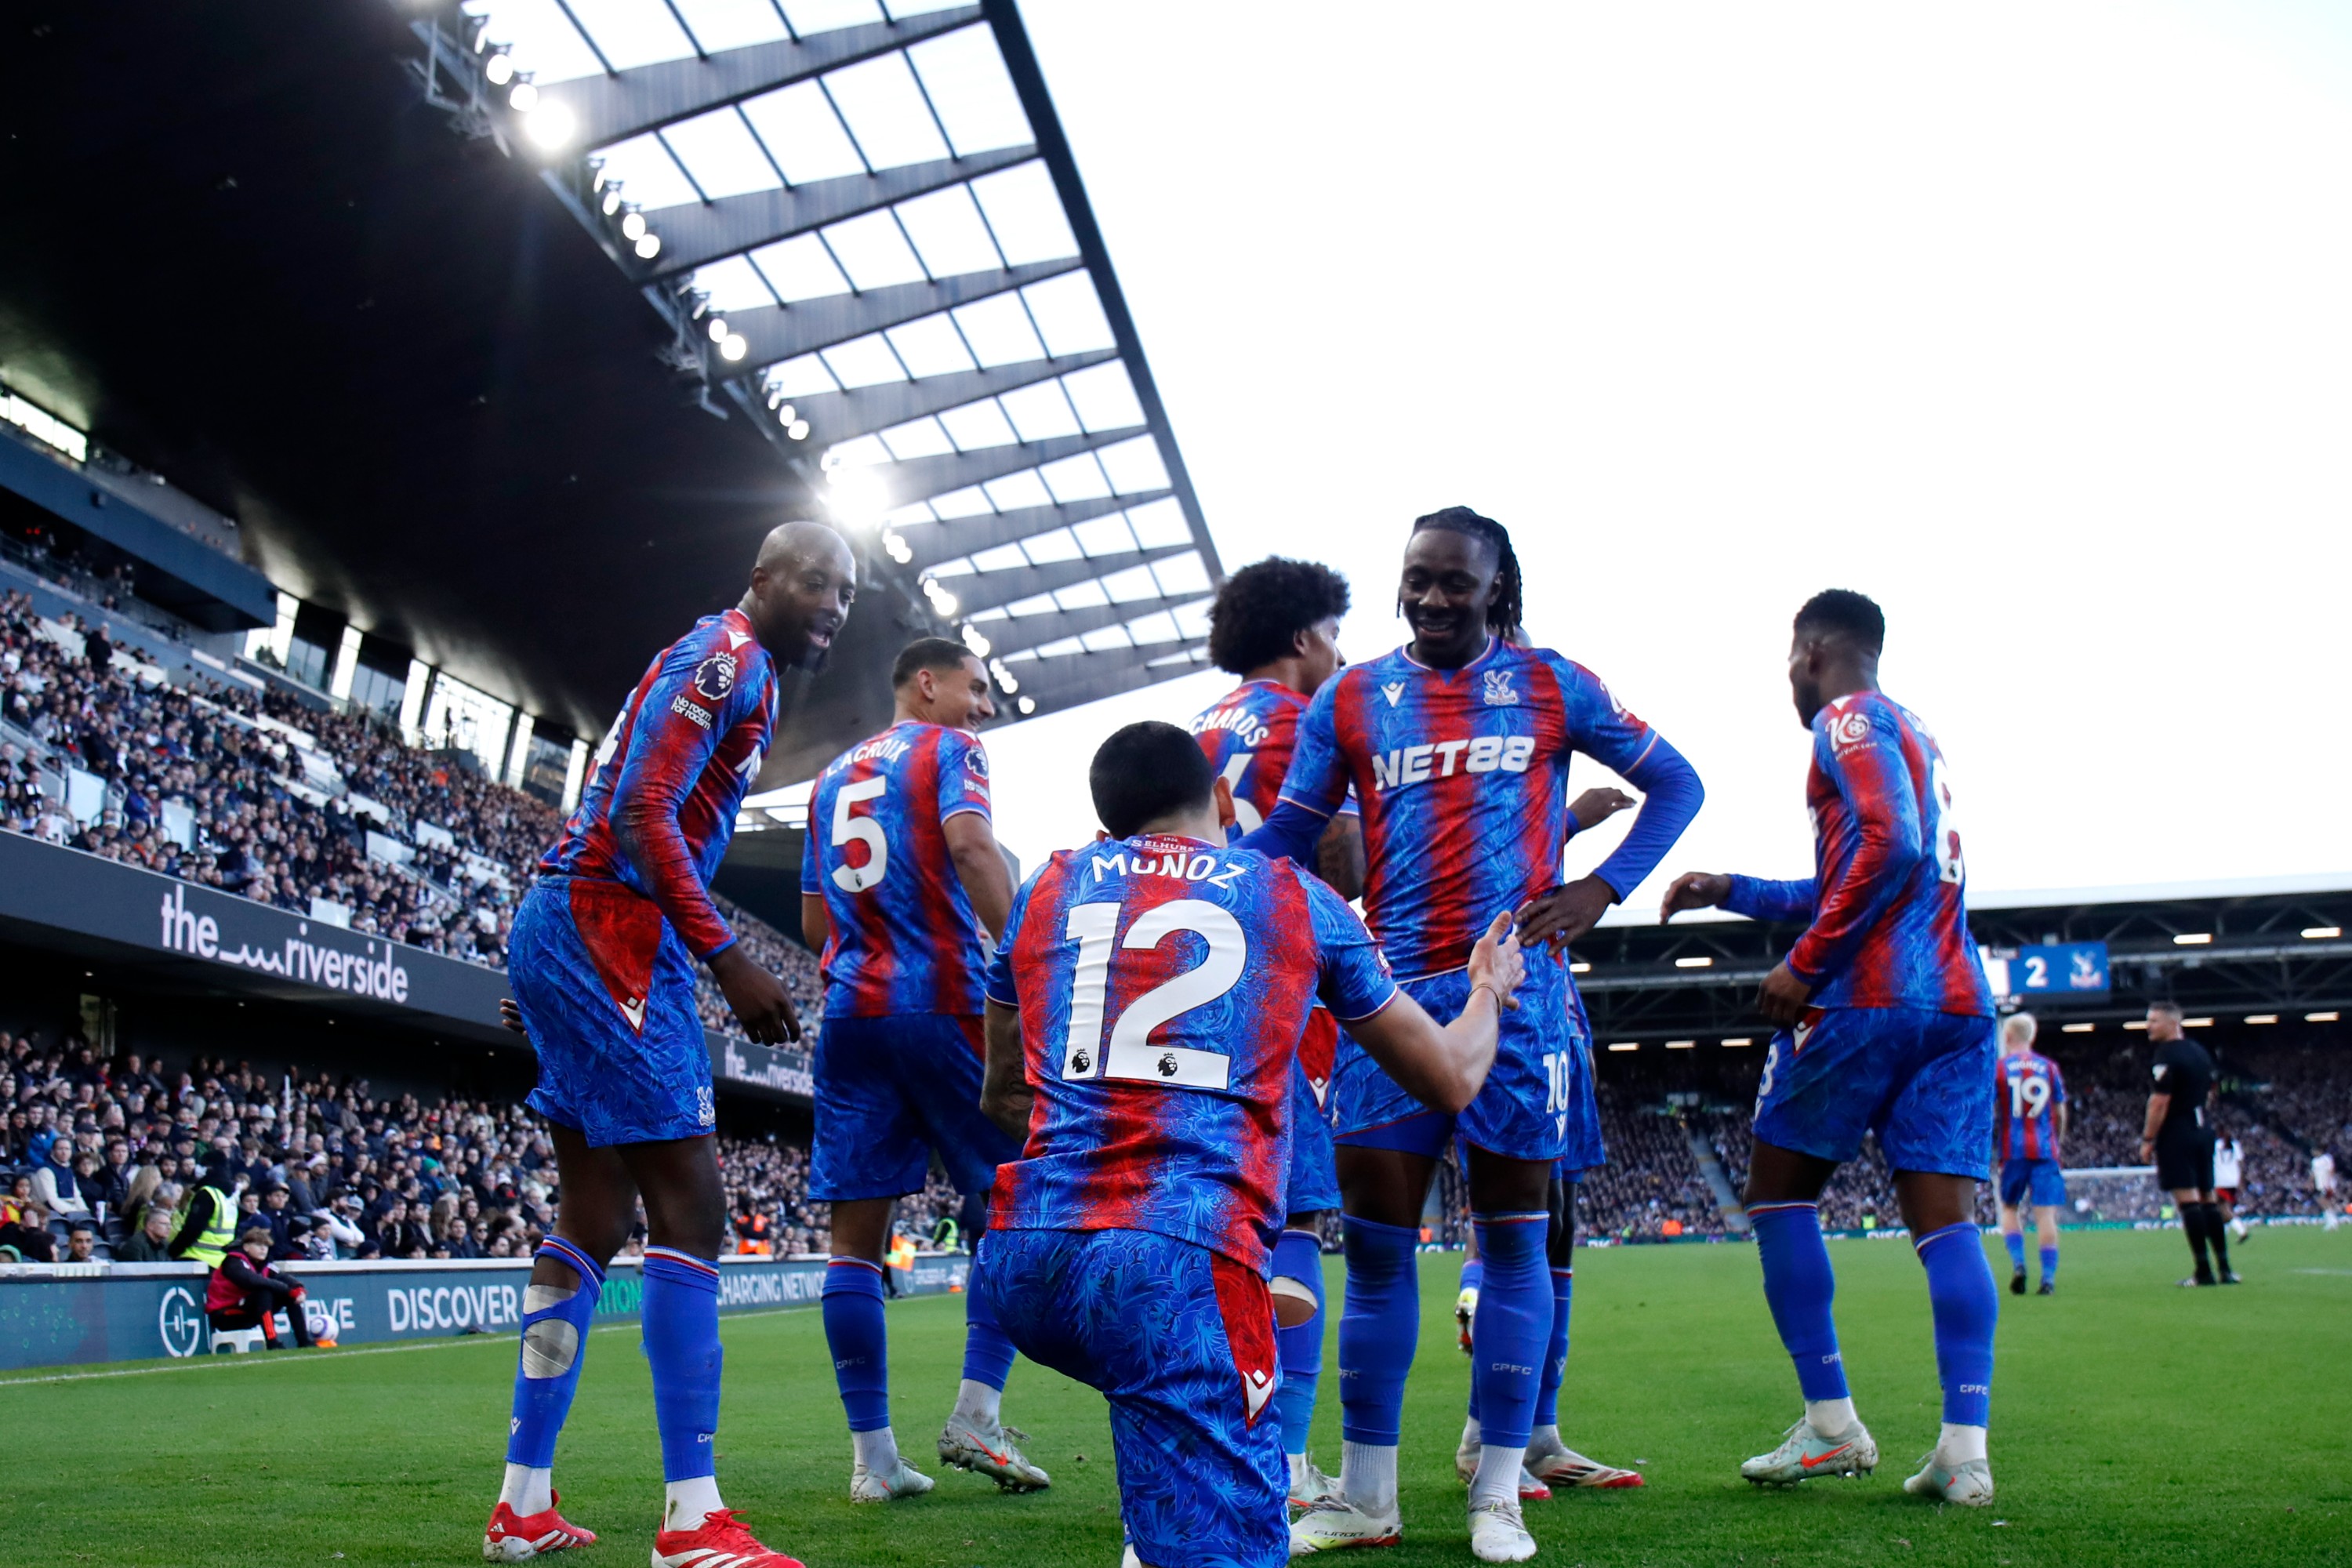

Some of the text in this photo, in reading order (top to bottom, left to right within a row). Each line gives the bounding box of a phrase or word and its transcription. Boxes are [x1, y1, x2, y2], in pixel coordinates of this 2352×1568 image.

[673, 694, 713, 722] No room
[684, 709, 711, 731] racism
[1188, 707, 1269, 747] CHARDS
[826, 738, 911, 778] LACROIX
[1372, 735, 1535, 791] NET88
[831, 775, 887, 893] 5
[1131, 839, 1196, 852] SELHURS
[161, 883, 409, 1004] the riverside
[2024, 955, 2048, 988] 2
[1062, 898, 1247, 1091] 12
[1542, 1050, 1569, 1113] 10
[2007, 1076, 2051, 1119] 19
[387, 1284, 519, 1332] DISCOVER
[781, 1271, 828, 1301] NETWO
[836, 1356, 866, 1370] CPFC
[1338, 1368, 1359, 1380] PFC
[1492, 1363, 1533, 1375] CPFC
[1960, 1384, 1988, 1396] CPFC
